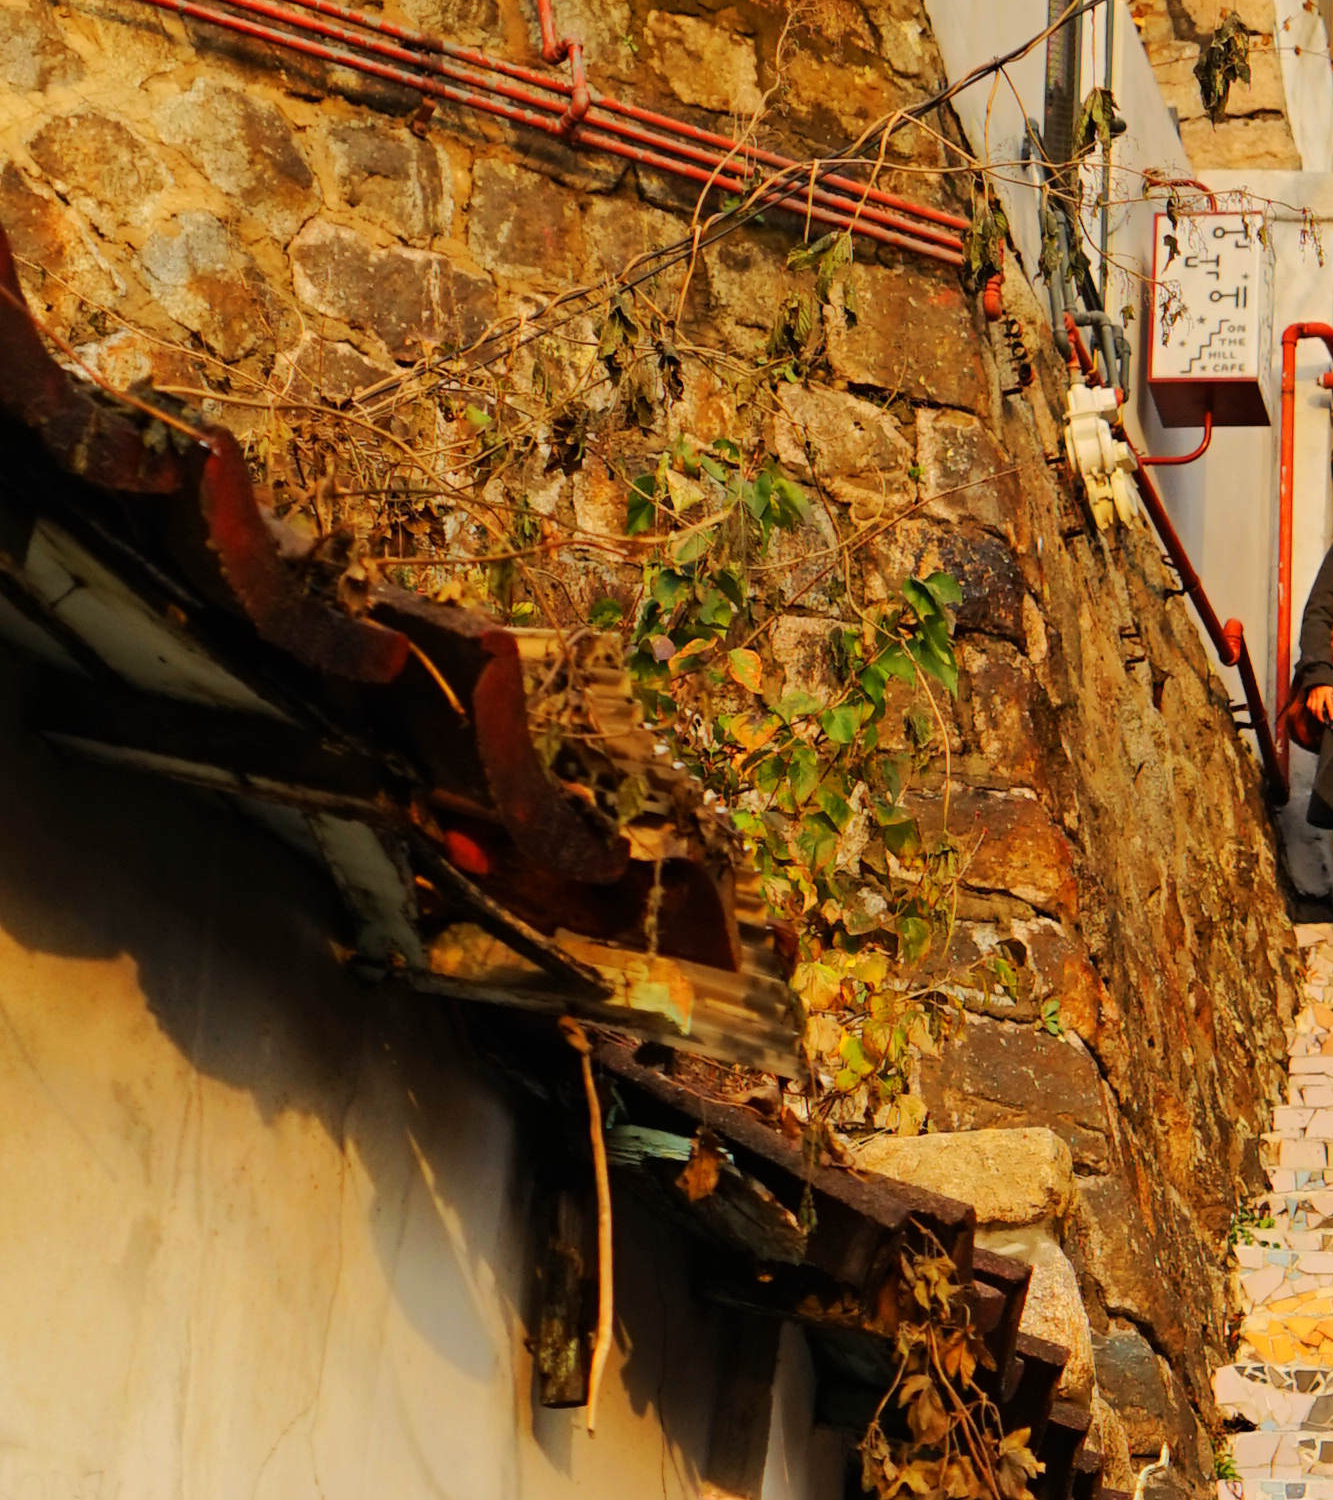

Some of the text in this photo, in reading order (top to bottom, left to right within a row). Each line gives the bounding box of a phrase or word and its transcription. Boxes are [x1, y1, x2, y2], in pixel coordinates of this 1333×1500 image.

[1228, 324, 1246, 332] ON
[1220, 338, 1246, 346] THE
[1208, 351, 1236, 360] HILL
[1212, 364, 1246, 372] CAFE
